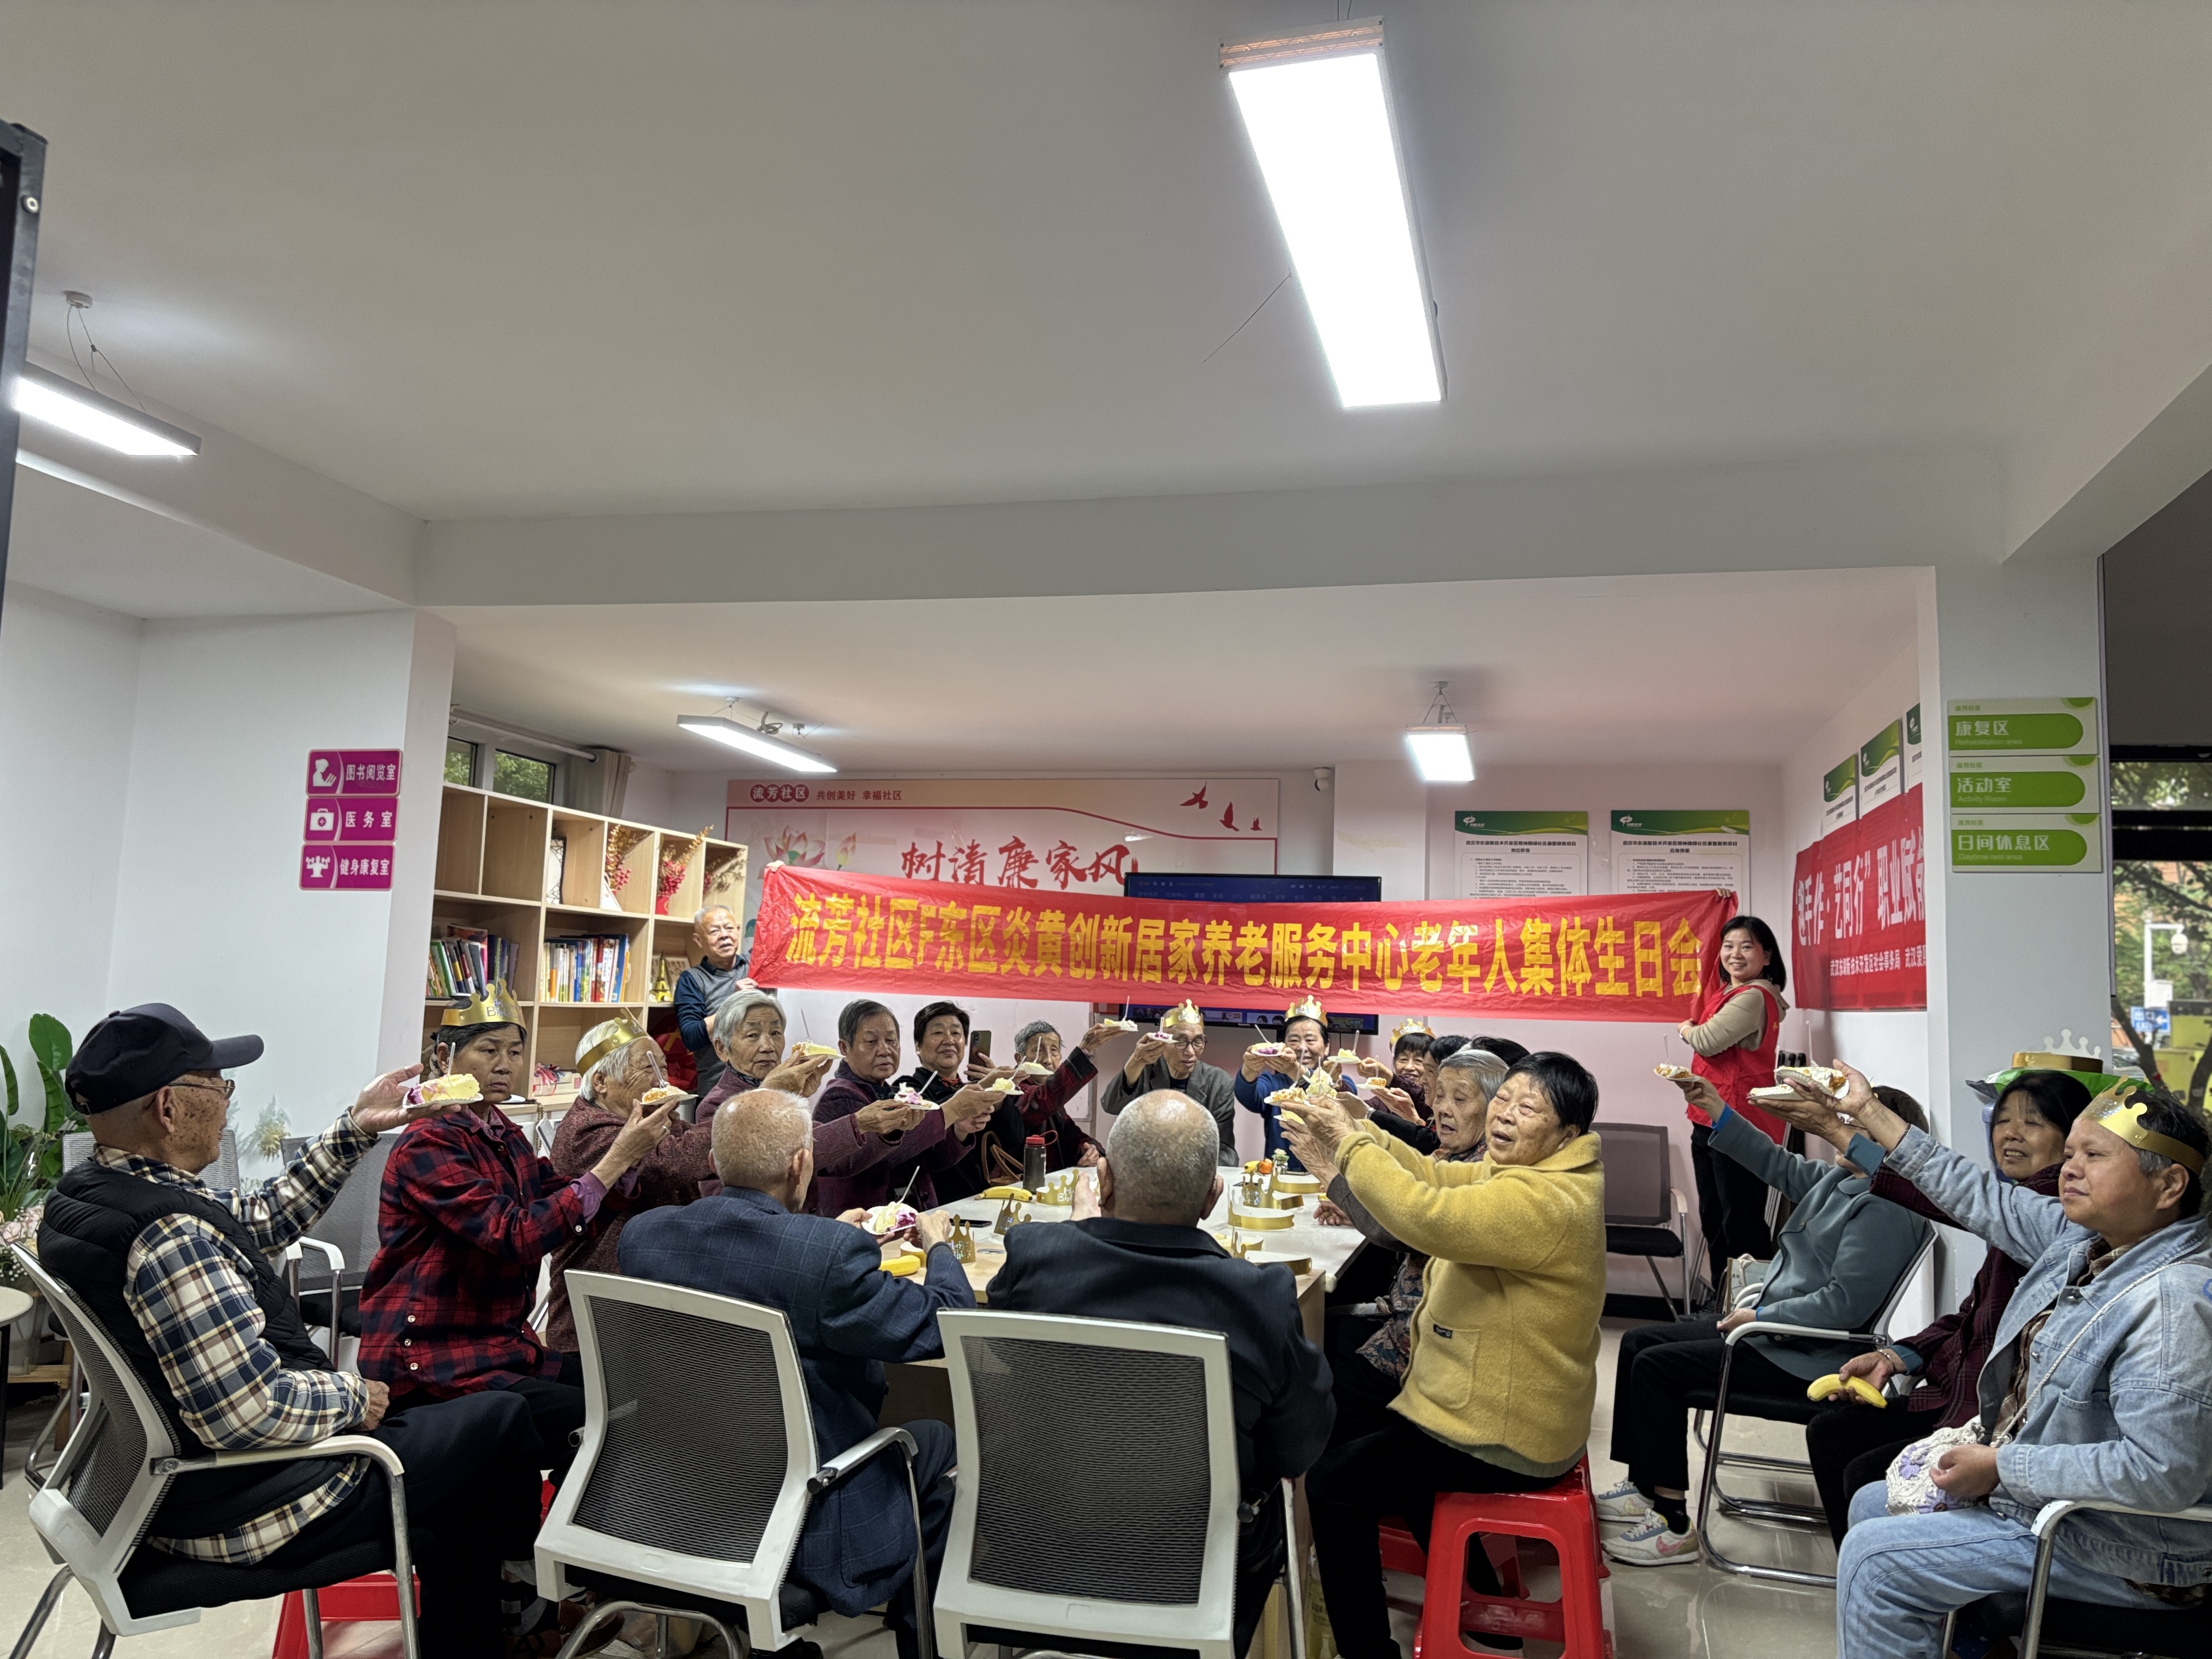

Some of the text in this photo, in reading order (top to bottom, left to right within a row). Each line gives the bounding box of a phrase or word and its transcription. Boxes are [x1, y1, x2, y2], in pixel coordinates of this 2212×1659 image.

[1956, 720, 2009, 736] 康复区
[346, 764, 396, 781] 图书阅览室
[1957, 777, 2012, 793] 活动室
[752, 787, 902, 800] 流芳社区 共创美好 幸福社区
[345, 811, 393, 828] 医务室
[1958, 835, 2050, 850] 日间休息区
[340, 859, 390, 876] 健身康复室
[901, 836, 1138, 890] 树清廉家风
